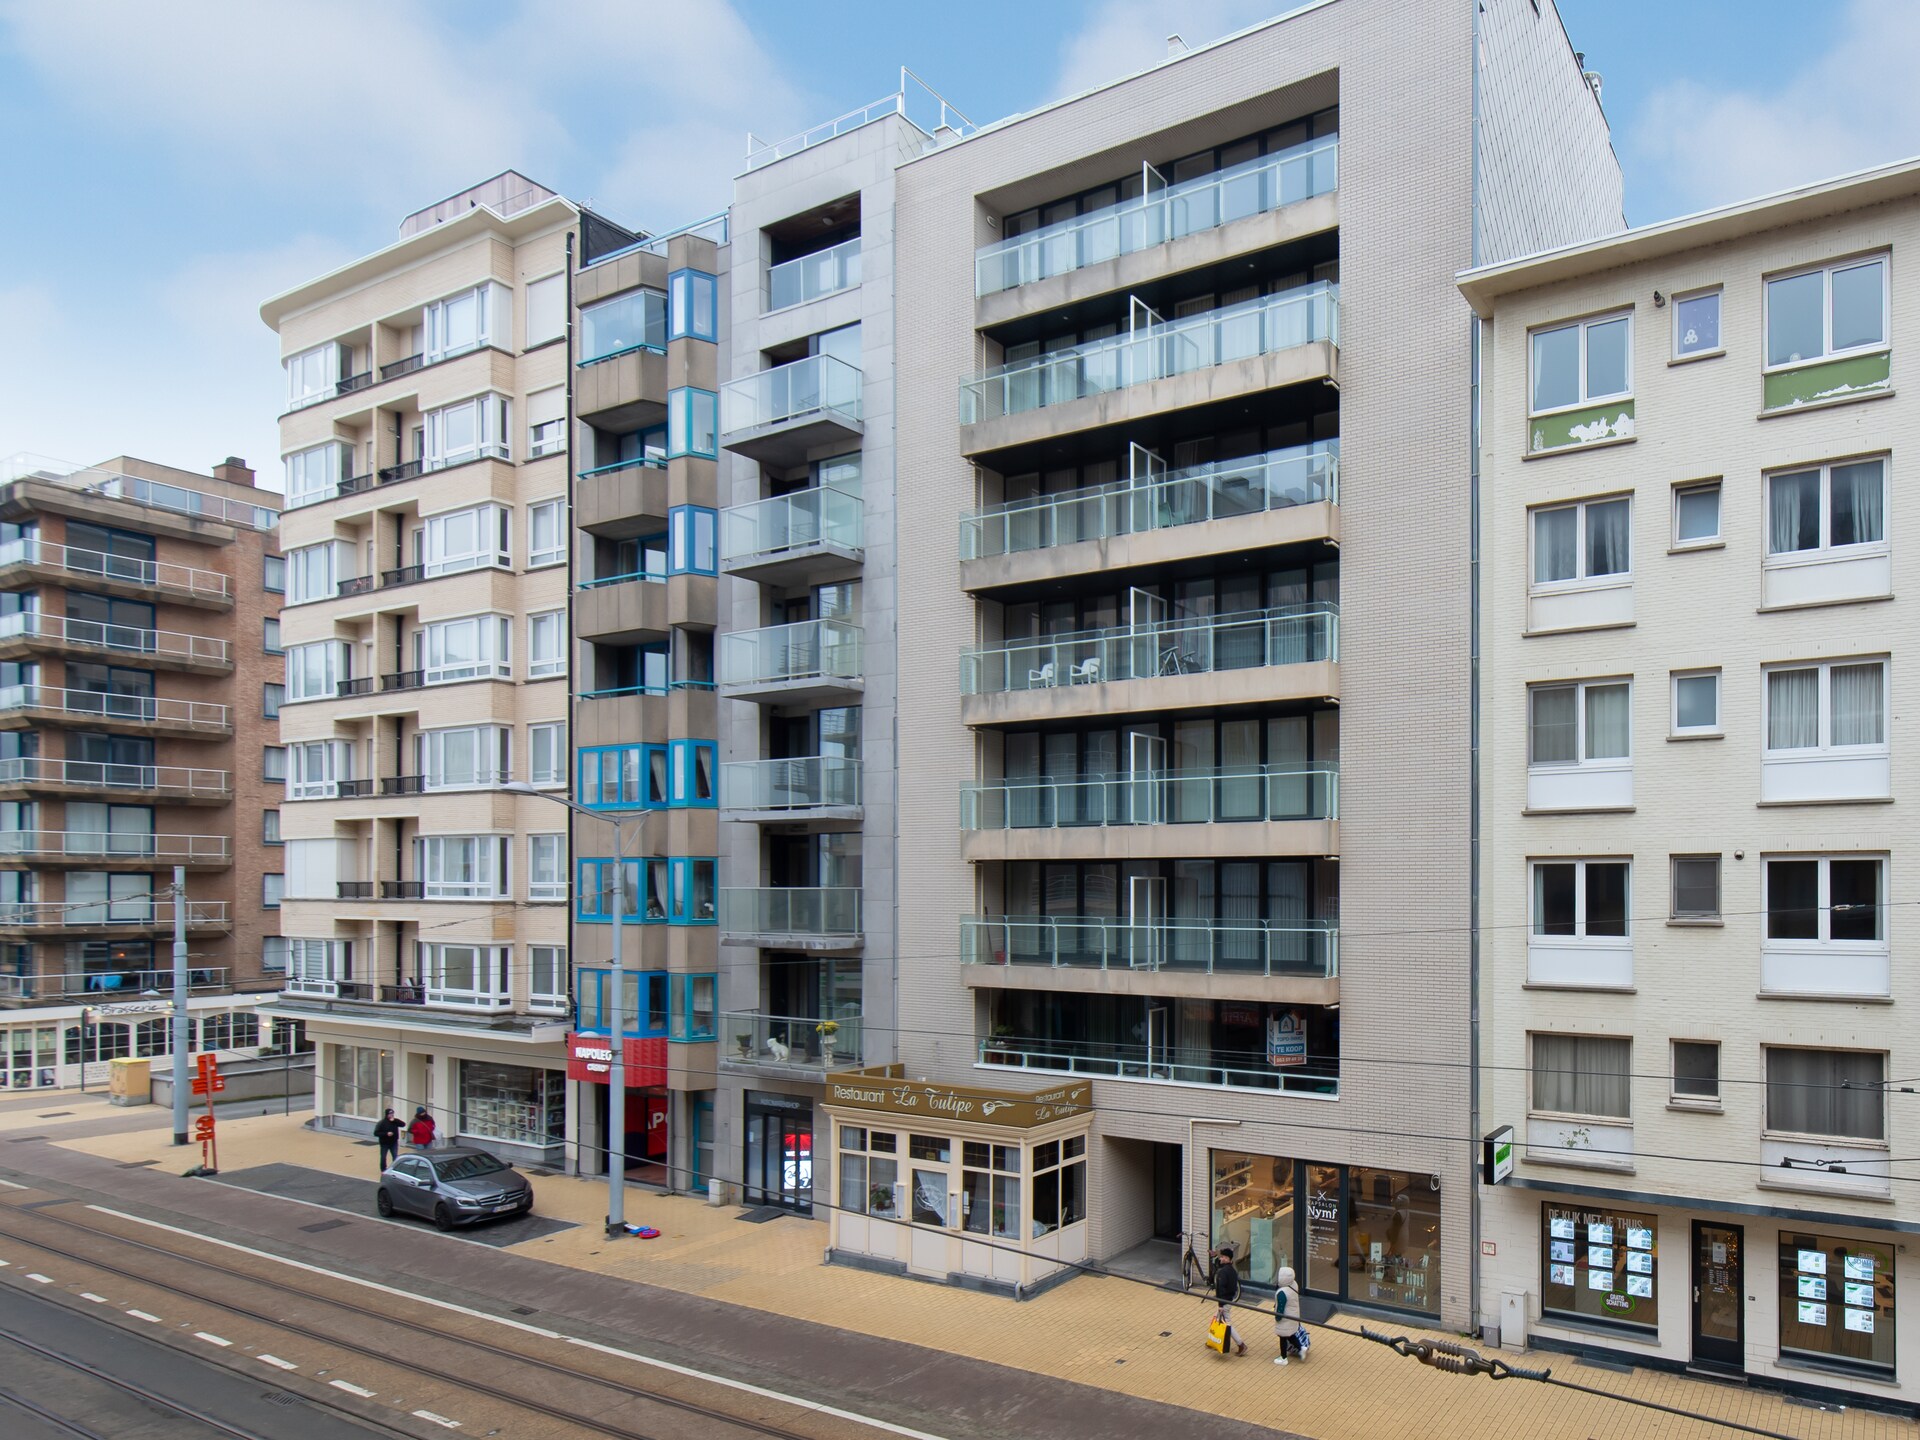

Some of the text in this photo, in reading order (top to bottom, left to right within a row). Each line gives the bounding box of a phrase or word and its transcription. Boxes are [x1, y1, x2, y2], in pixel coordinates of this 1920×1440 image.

[100, 1002, 158, 1015] Brasserie
[834, 1085, 974, 1118] Restaurant La Tulipe
[1035, 1090, 1065, 1103] Restaurant
[1035, 1106, 1051, 1120] La
[1307, 1205, 1338, 1219] Nymf
[1548, 1208, 1559, 1220] DE
[1583, 1212, 1602, 1225] MET
[1603, 1215, 1613, 1227] JE
[1616, 1217, 1643, 1231] THUIS
